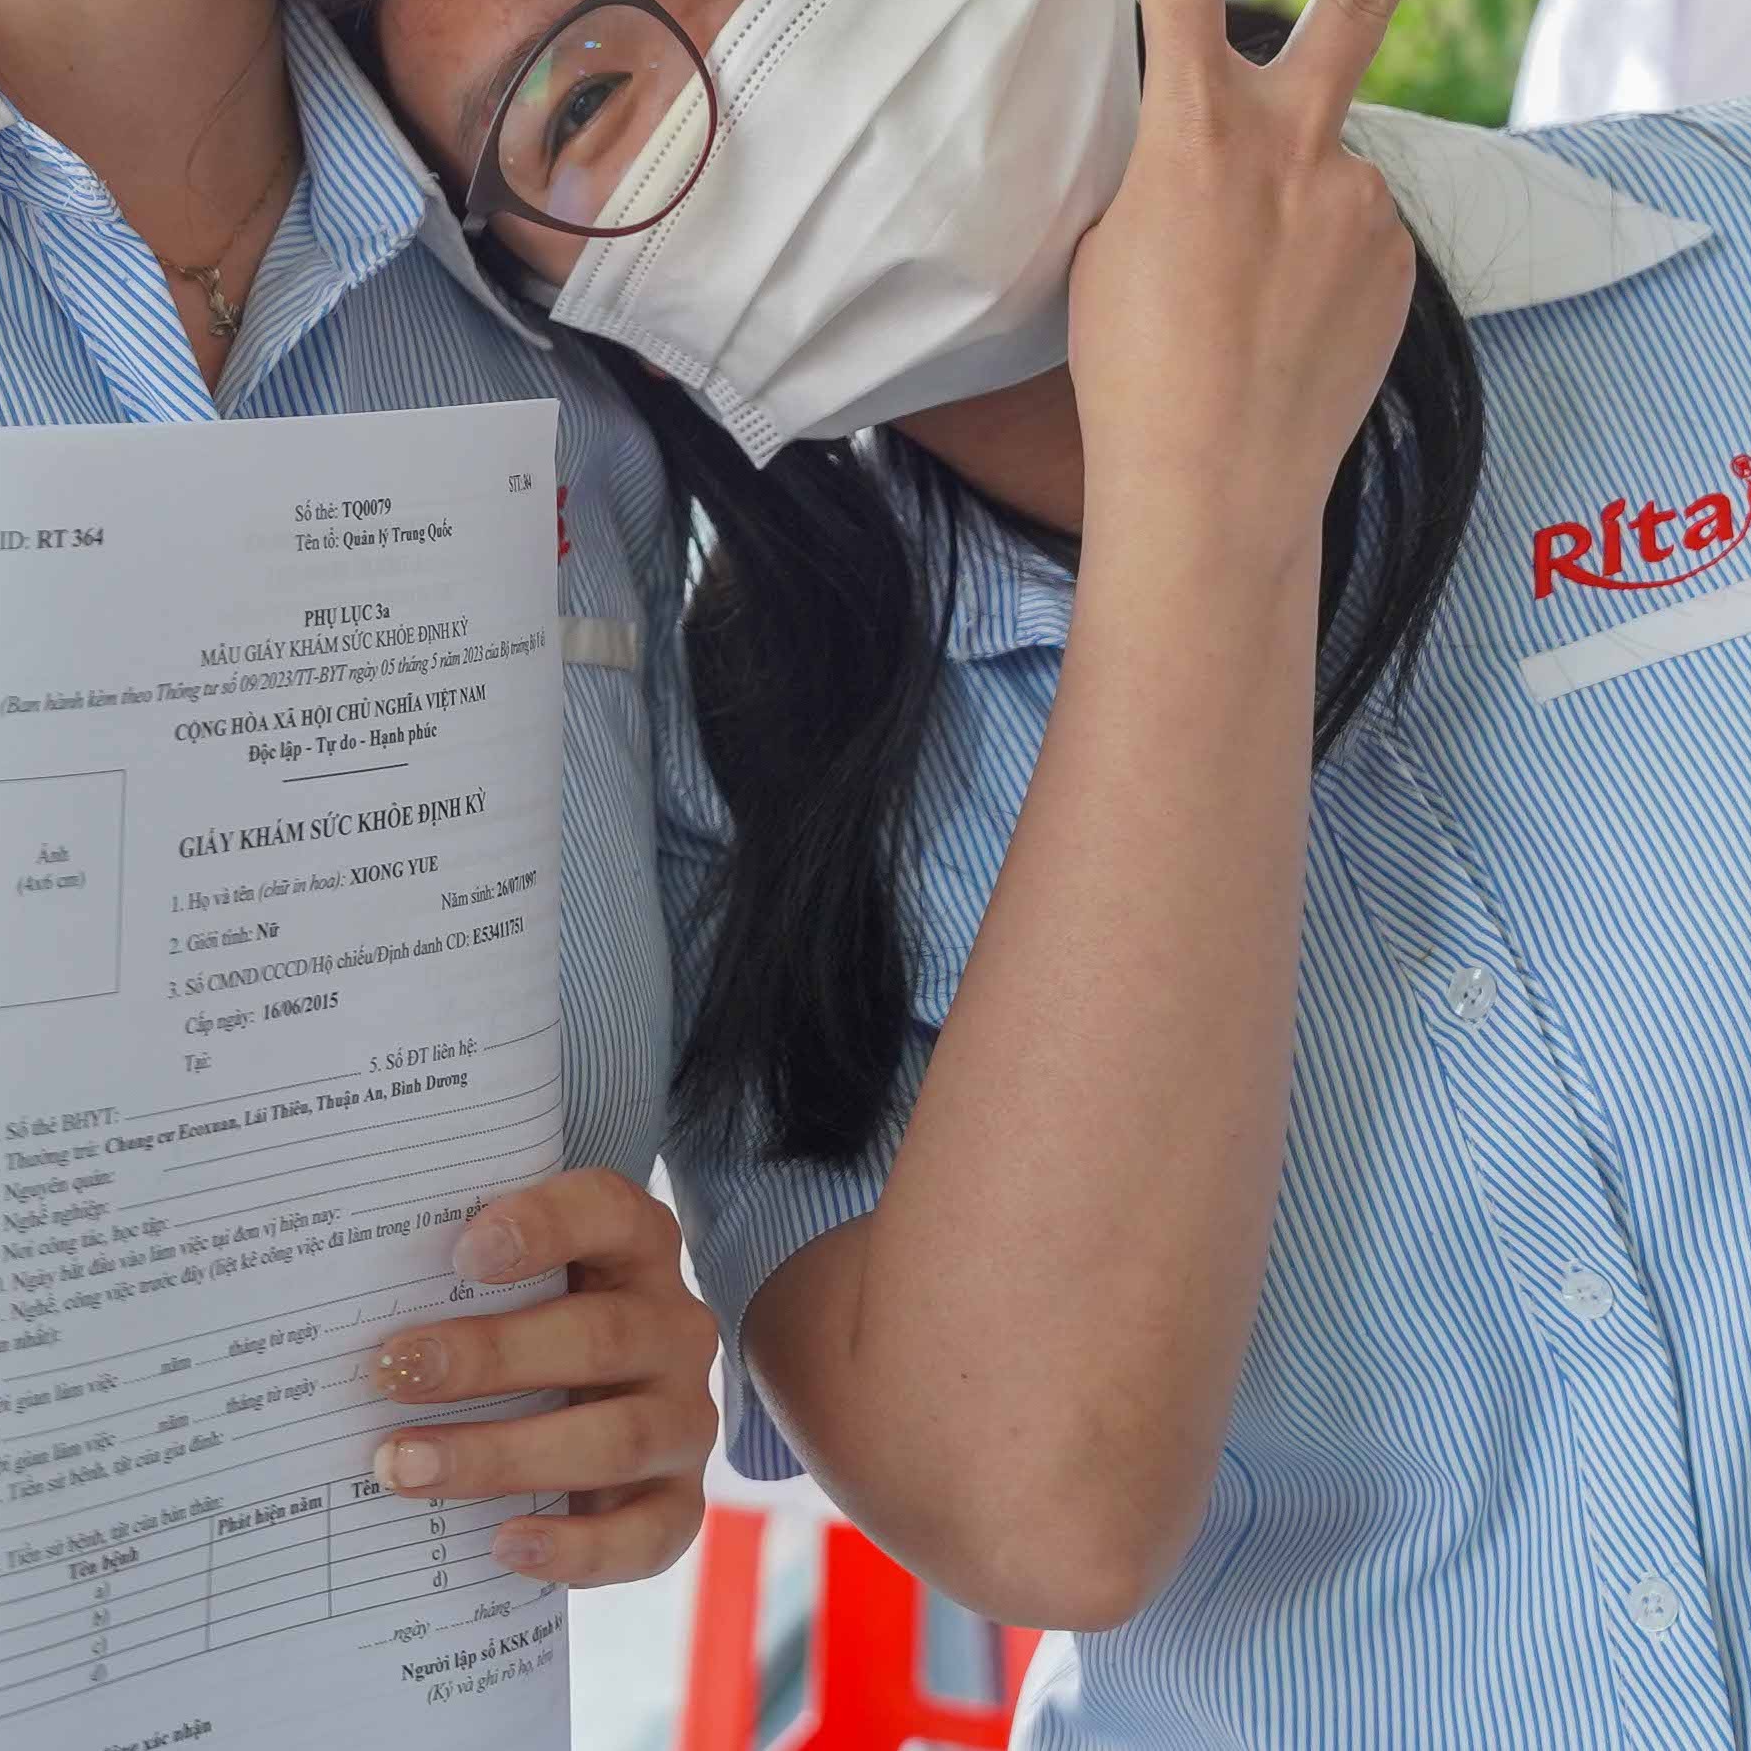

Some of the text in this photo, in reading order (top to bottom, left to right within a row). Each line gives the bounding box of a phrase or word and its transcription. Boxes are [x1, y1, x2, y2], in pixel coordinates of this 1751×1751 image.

[295, 500, 312, 522] Số
[343, 498, 391, 521] TQ0079
[0, 528, 104, 550] ID: RT 364
[295, 532, 320, 551] Tên
[379, 527, 389, 547] lý
[392, 525, 425, 544] Trung
[428, 518, 452, 540] Quốc
[1533, 492, 1737, 601] Rita
[305, 603, 390, 629] PHỤ LỤC 3a
[289, 633, 339, 657] KHÁM
[342, 629, 373, 652] SỨC
[418, 622, 450, 645] ĐỊNH
[451, 615, 468, 638] KỲ
[349, 660, 378, 684] ngày
[380, 659, 395, 676] 05
[398, 654, 429, 675] tháng
[440, 650, 460, 668] năm
[462, 645, 484, 665] 2023
[174, 684, 487, 743] CỘNG HÒA XÃ HỘI CHỦ NGHĨA VIỆT NAM
[248, 722, 438, 765] Độc lập Tự do Hạnh phúc
[239, 818, 304, 850] KHÁM
[310, 811, 353, 840] SỨC
[418, 796, 460, 827] ĐỊNH
[465, 786, 487, 815] KỲ
[170, 895, 184, 913] 1.
[233, 884, 254, 902] tên
[293, 878, 307, 894] in
[309, 871, 346, 892] hoa):
[350, 861, 403, 886] XIONG
[408, 855, 439, 875] YUE
[257, 921, 280, 941] Nữ
[441, 892, 469, 910] Năm
[471, 883, 495, 904] sinh:
[414, 937, 443, 957] danh
[446, 931, 470, 950] CD:
[262, 991, 339, 1020] 16/06/2015
[369, 1056, 381, 1073] 5.
[386, 1048, 403, 1070] Số
[407, 1047, 428, 1066] ĐT
[433, 1042, 455, 1062] liên
[459, 1038, 478, 1057] hệ:
[317, 1091, 359, 1110] Thuận
[363, 1089, 387, 1103] An,
[391, 1078, 421, 1098] Bình
[426, 1072, 467, 1091] Dương
[263, 1220, 277, 1240] vị
[280, 1213, 309, 1234] hiện
[312, 1208, 340, 1227] nay:
[328, 1231, 344, 1249] đã
[348, 1226, 372, 1245] làm
[376, 1219, 411, 1237] trong
[415, 1211, 431, 1229] 10
[434, 1207, 462, 1226] năm
[465, 1196, 489, 1222] gầ
[449, 1279, 475, 1303] đến
[352, 1479, 380, 1499] Tên
[430, 1516, 447, 1537] b)
[431, 1543, 448, 1562] c)
[433, 1570, 449, 1589] d)
[400, 1654, 451, 1682] Người
[454, 1650, 477, 1672] lập
[499, 1630, 530, 1656] KSK
[532, 1620, 554, 1644] định
[427, 1680, 453, 1706] (Ký
[457, 1676, 474, 1695] và
[477, 1669, 498, 1693] ghi
[502, 1665, 516, 1681] rõ
